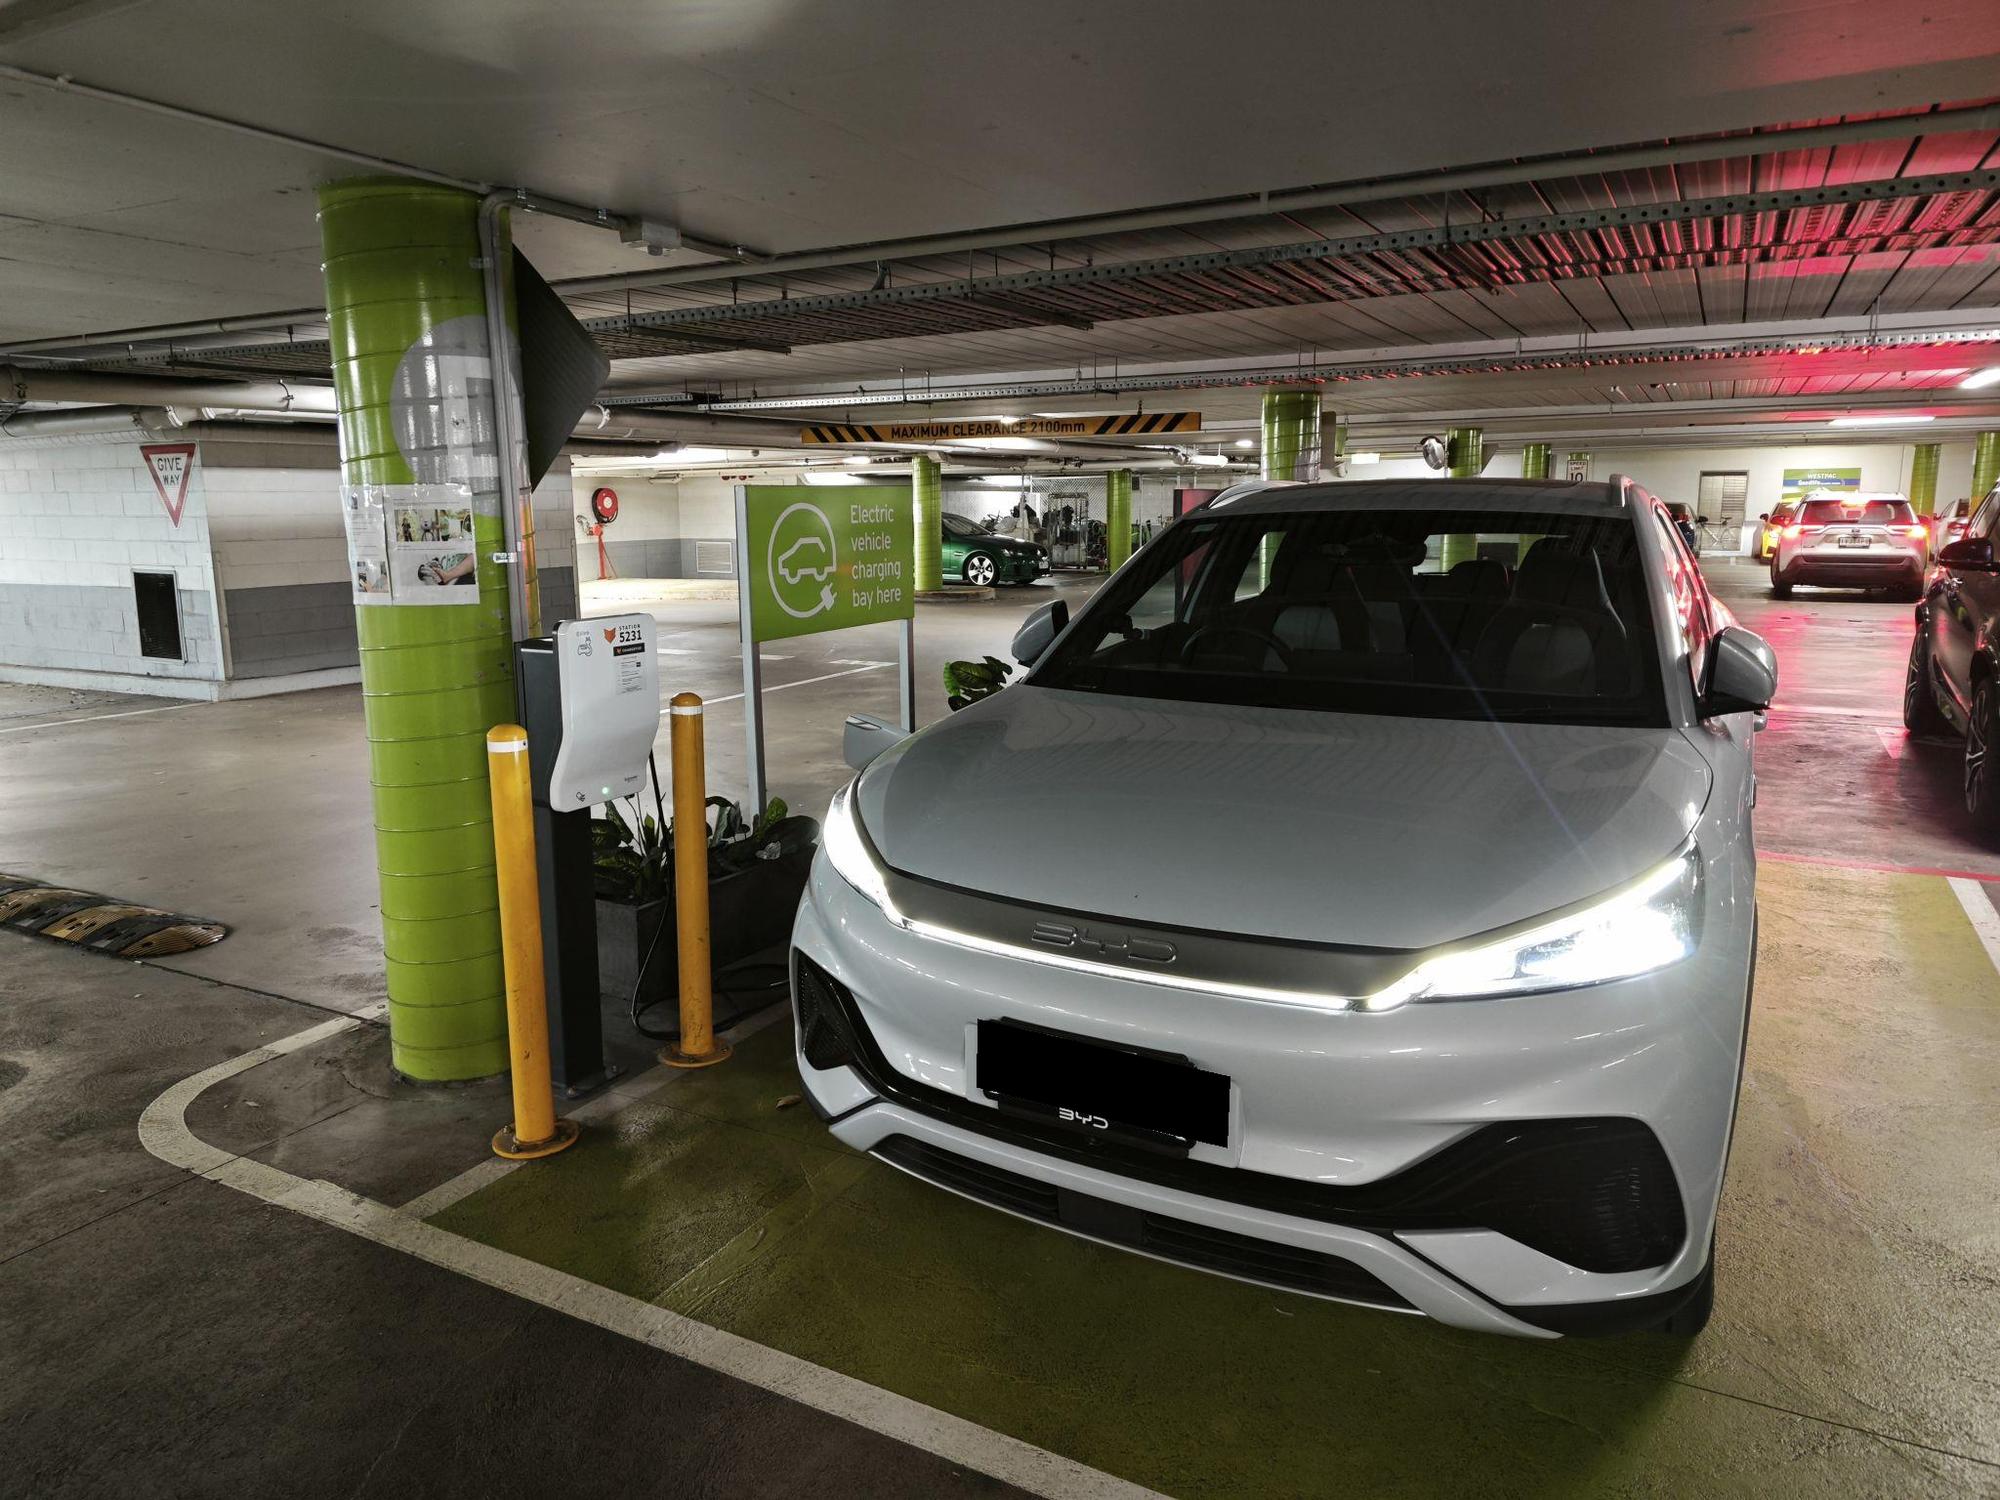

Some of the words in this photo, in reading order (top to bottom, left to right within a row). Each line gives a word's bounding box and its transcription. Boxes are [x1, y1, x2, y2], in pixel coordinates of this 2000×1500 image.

[890, 422, 950, 439] MAXIMUM
[952, 421, 1027, 437] CLEARANCE
[1030, 420, 1086, 434] 2100mm
[157, 457, 182, 471] GIVE
[163, 475, 180, 485] WAY
[1570, 472, 1584, 482] 10
[850, 503, 895, 524] Electric
[851, 532, 891, 551] vehicle
[852, 559, 902, 581] charging
[852, 589, 874, 610] bay
[876, 586, 902, 604] here
[619, 629, 642, 643] 5231
[1031, 920, 1178, 964] BYD
[1058, 1106, 1109, 1130] BYD
